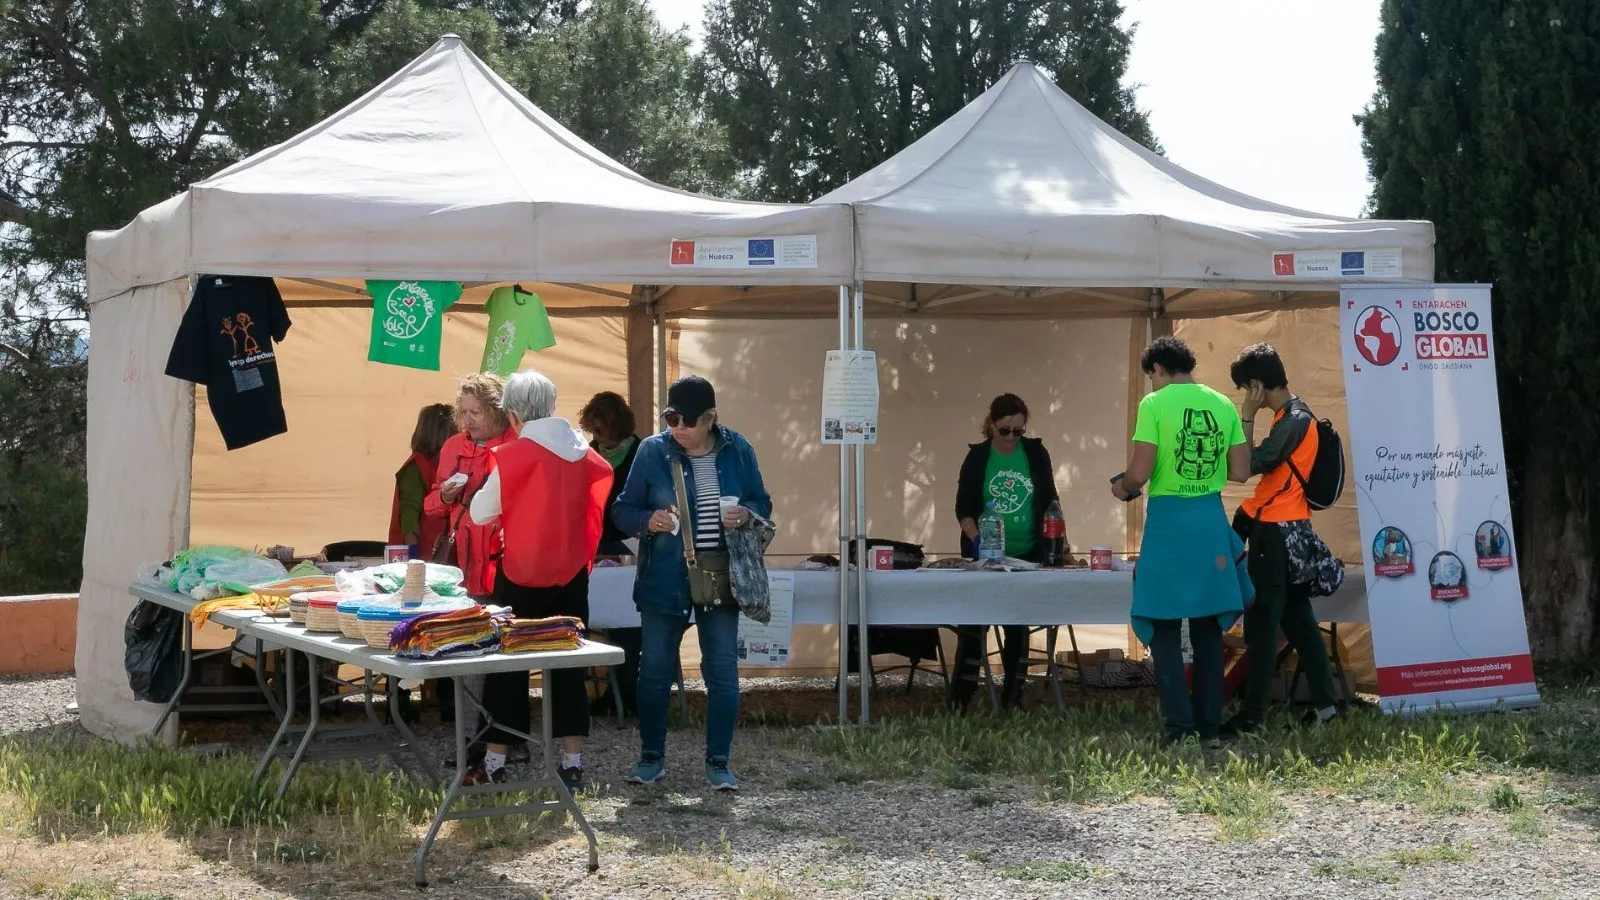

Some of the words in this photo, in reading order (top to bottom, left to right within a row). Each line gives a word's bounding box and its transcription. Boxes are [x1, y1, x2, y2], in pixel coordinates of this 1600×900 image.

[1412, 300, 1468, 309] ENTARACHEN
[1413, 311, 1479, 331] BOSCO
[1416, 336, 1487, 358] GLOBAL
[1375, 446, 1398, 461] Por
[1400, 453, 1414, 461] un
[1415, 443, 1444, 460] mundo
[1364, 465, 1410, 490] equitativo
[1412, 472, 1420, 488] y
[1401, 670, 1414, 679] Más
[1415, 668, 1451, 678] información
[1461, 662, 1512, 673] boscoglobal.org
